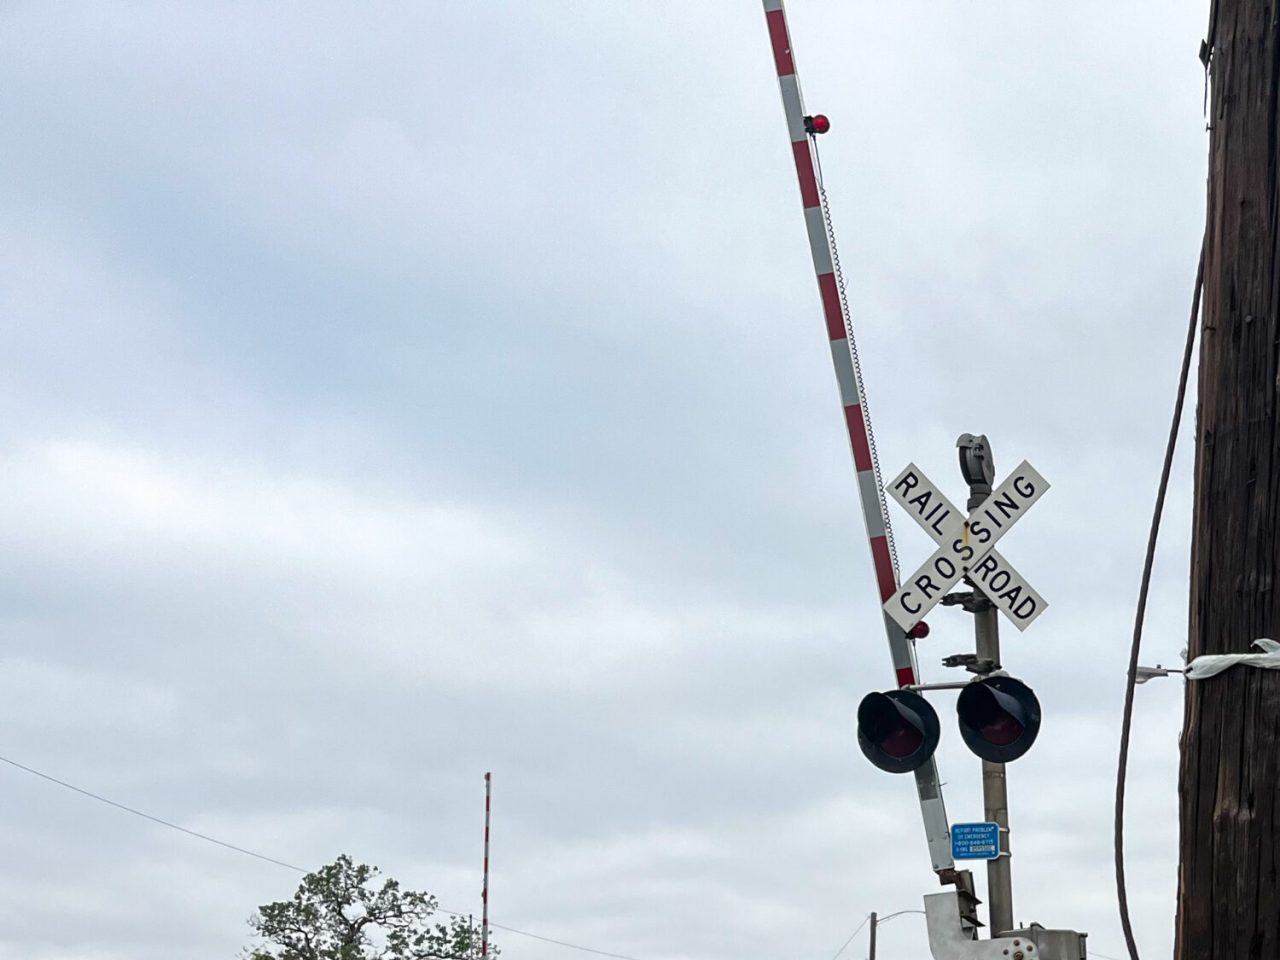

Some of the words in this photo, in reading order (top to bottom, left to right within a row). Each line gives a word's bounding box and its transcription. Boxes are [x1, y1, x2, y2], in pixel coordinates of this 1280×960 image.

[894, 471, 951, 536] RAIL
[973, 554, 1037, 620] ROAD
[900, 475, 1036, 615] CROSSING
